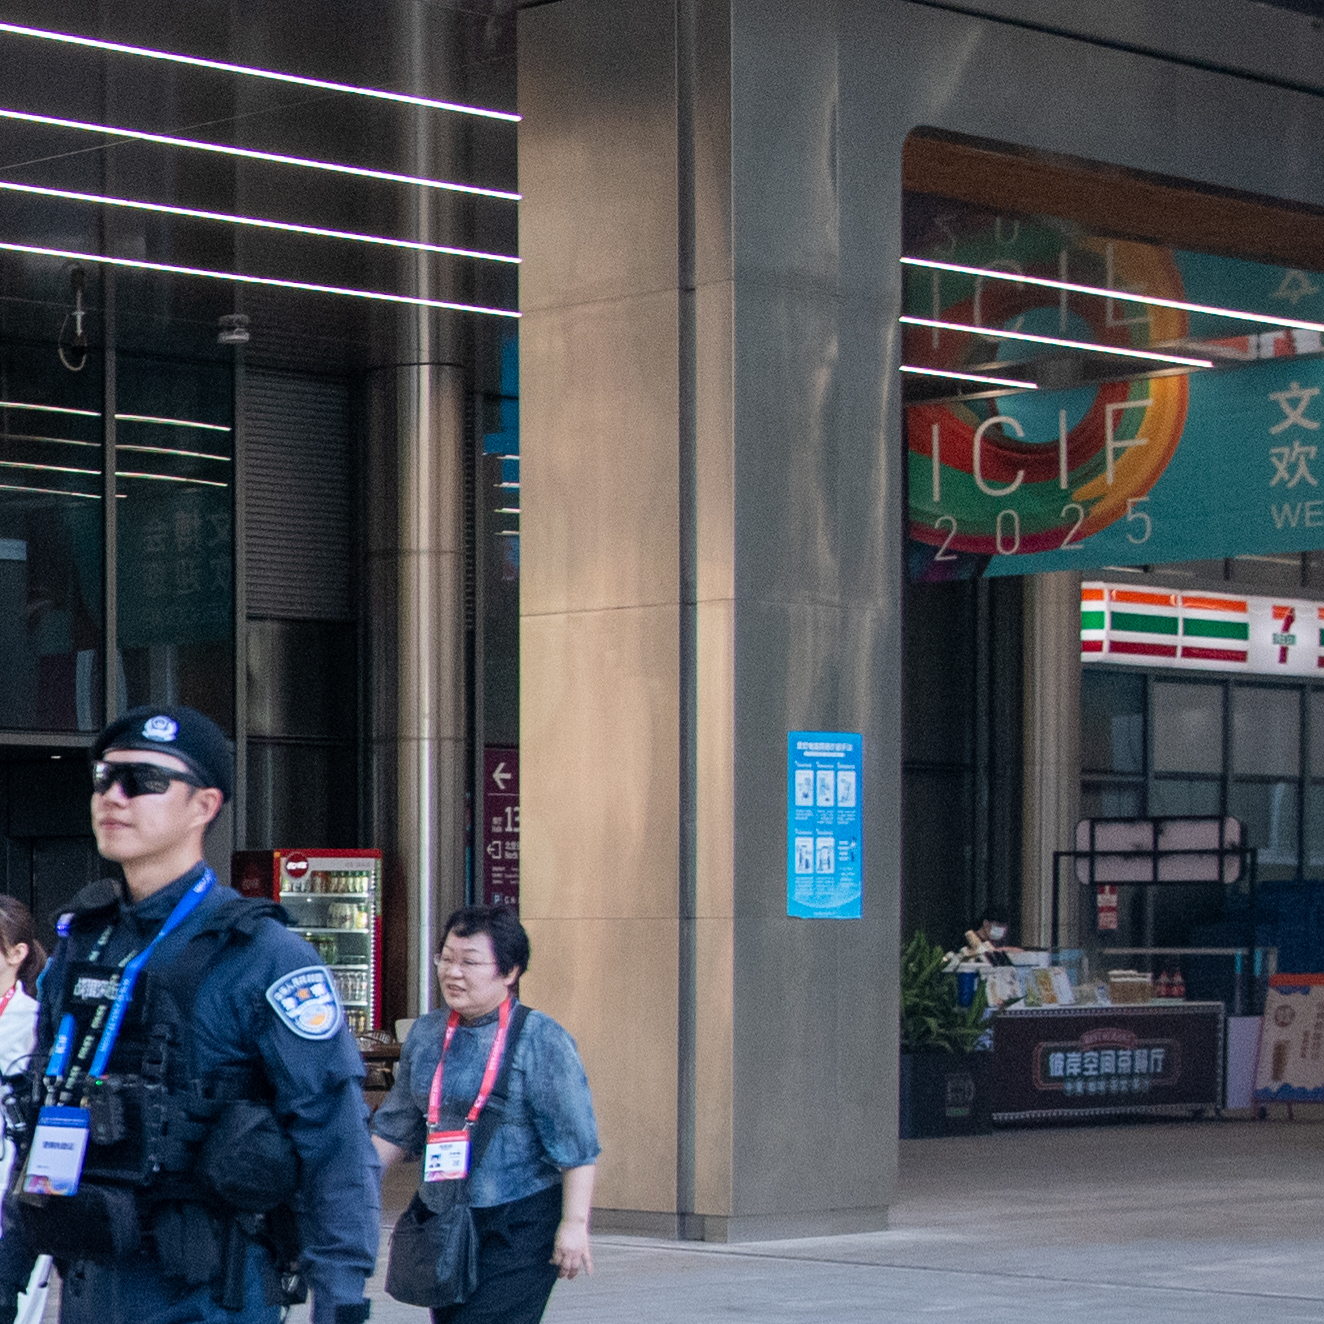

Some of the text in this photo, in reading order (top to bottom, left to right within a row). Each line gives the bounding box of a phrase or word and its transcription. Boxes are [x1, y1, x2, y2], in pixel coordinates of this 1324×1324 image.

[1268, 381, 1321, 435] 文
[932, 398, 1154, 502] ICIF
[1268, 441, 1319, 489] 欢
[934, 495, 1151, 561] 2025
